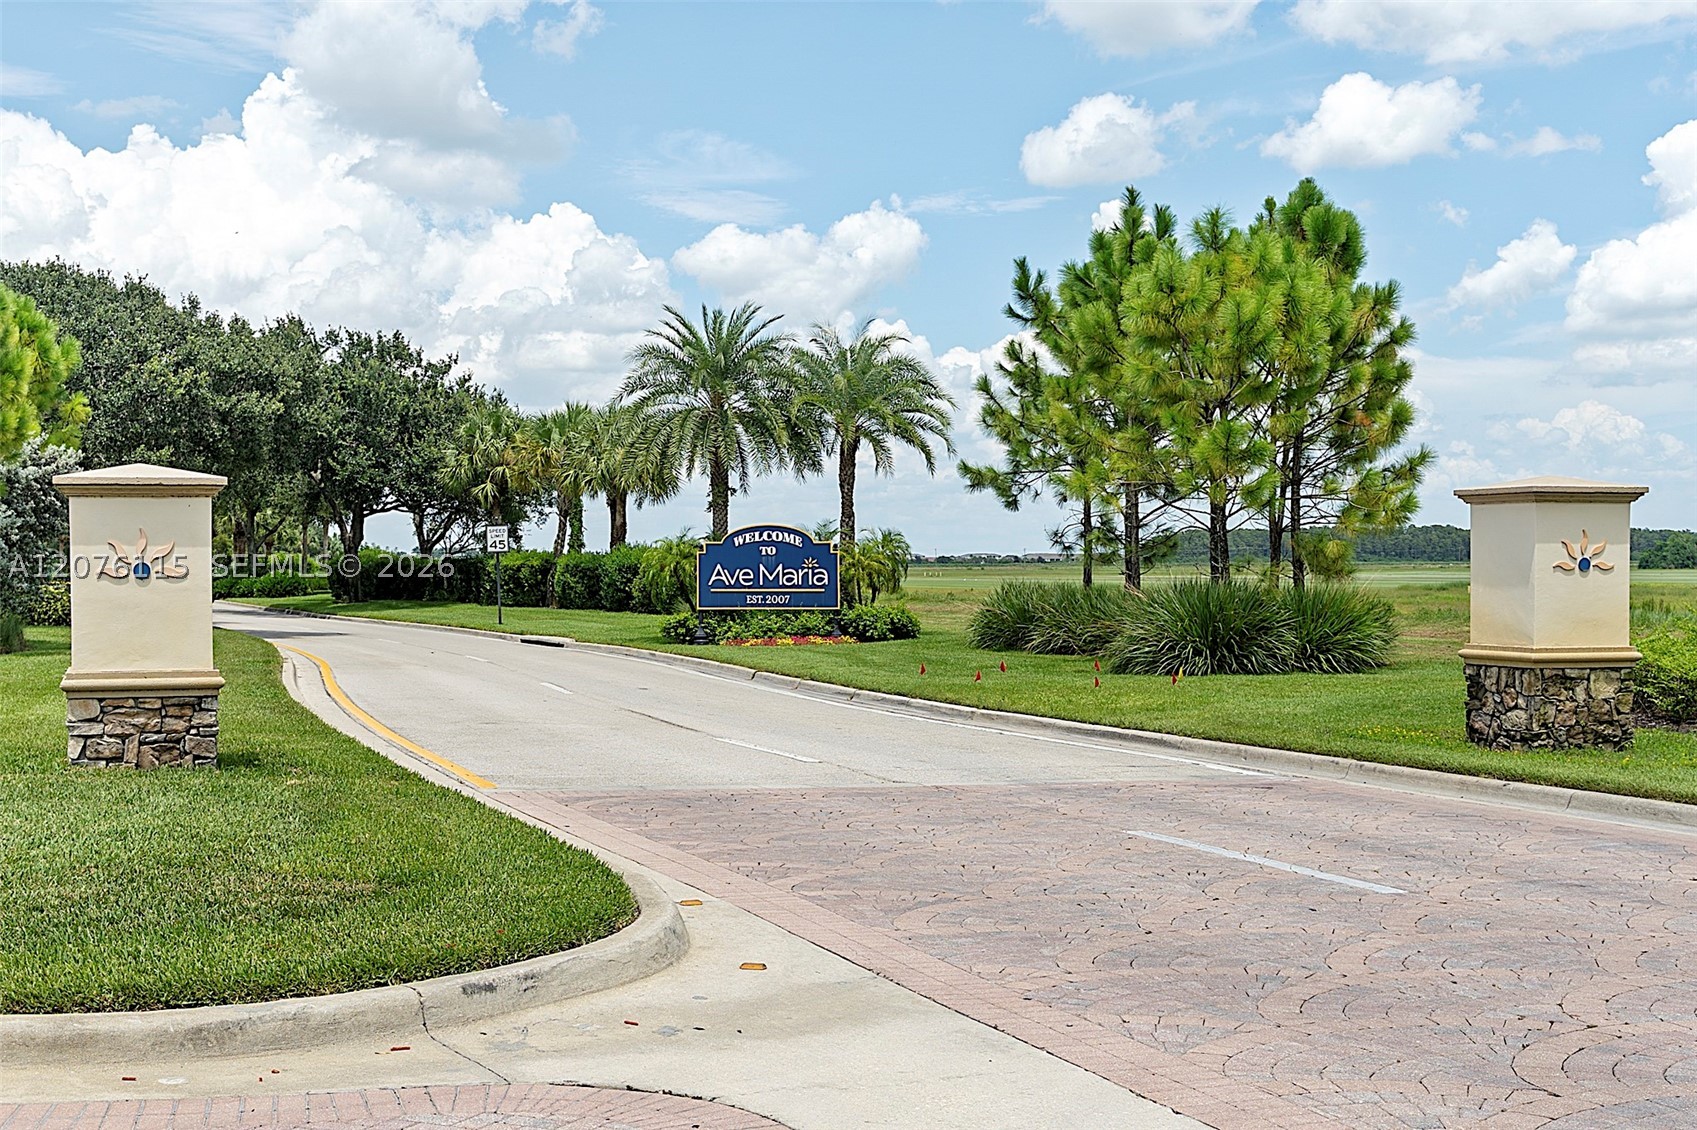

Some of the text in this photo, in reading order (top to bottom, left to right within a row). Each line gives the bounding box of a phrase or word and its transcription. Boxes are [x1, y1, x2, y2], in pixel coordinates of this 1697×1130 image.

[733, 530, 803, 547] WELCOME
[489, 540, 506, 550] 45
[759, 546, 776, 556] TO
[708, 562, 829, 586] Ave Maria
[746, 595, 790, 604] EST. 2007
